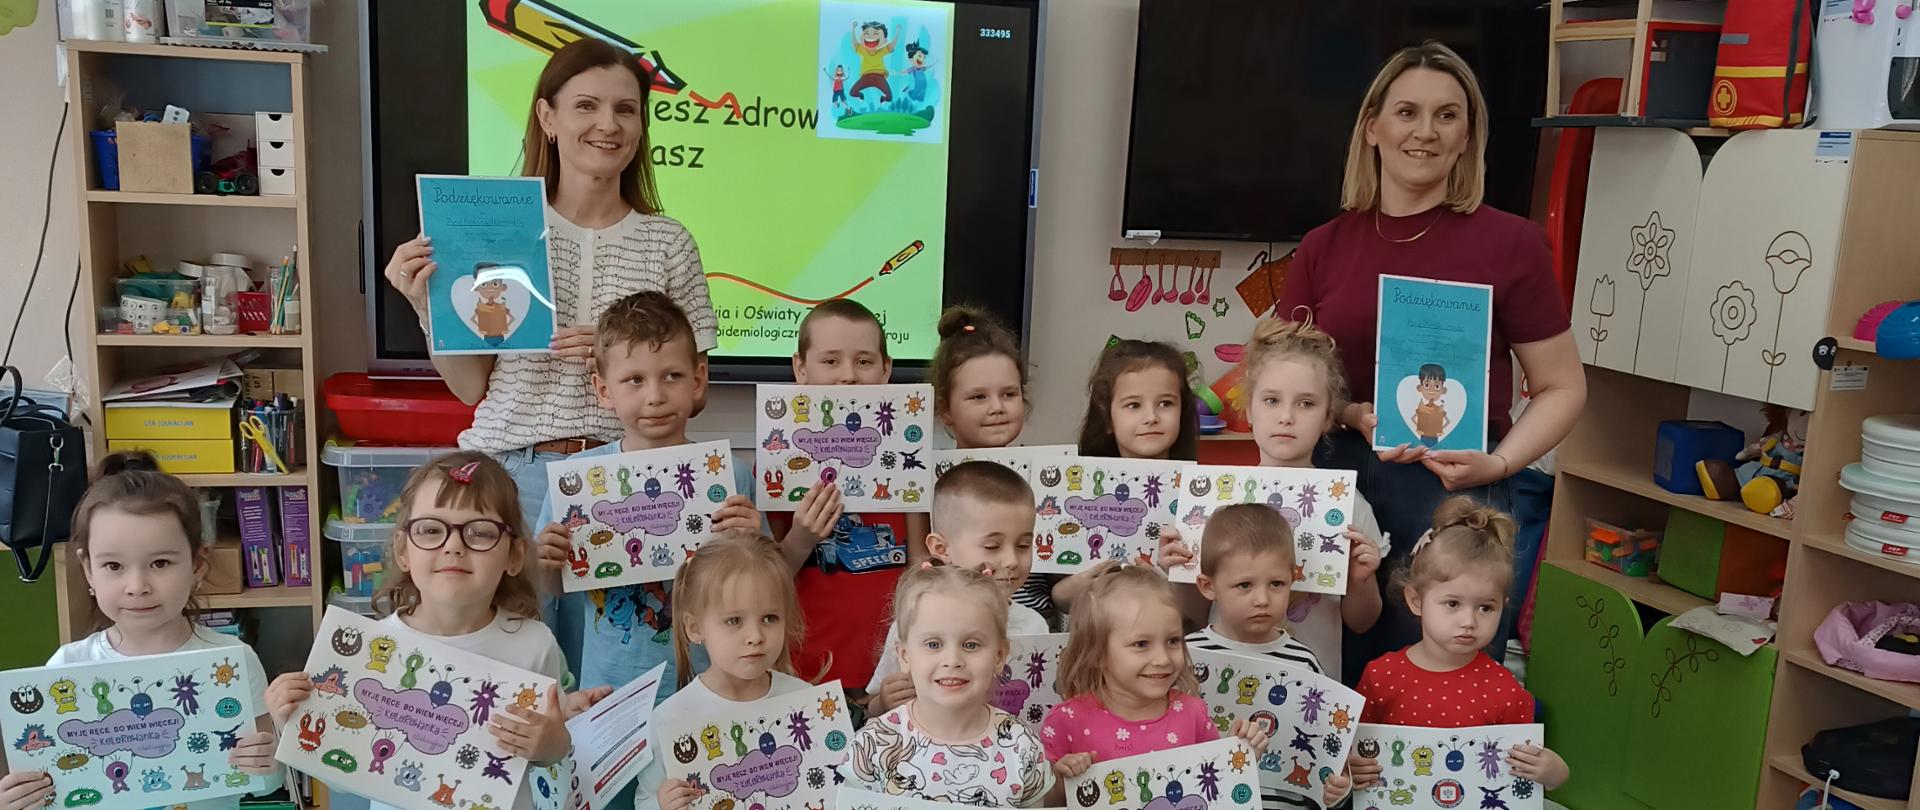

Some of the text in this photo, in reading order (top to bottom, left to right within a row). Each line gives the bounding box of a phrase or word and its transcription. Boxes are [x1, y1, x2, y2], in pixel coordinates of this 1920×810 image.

[979, 28, 1011, 39] 333495
[433, 186, 535, 206] Podziękowanie
[1393, 286, 1481, 312] Podziękowanie
[744, 305, 802, 325] Oświaty
[883, 329, 910, 345] roju
[852, 552, 902, 568] SPEED 6
[361, 688, 380, 703] MYJĘ
[381, 695, 400, 708] RĘCE
[403, 703, 414, 712] BO
[415, 707, 435, 719] WIEM
[67, 729, 88, 738] MYJĘ
[89, 727, 110, 735] RĘCE
[114, 725, 125, 733] BO
[127, 723, 147, 731] WIEM
